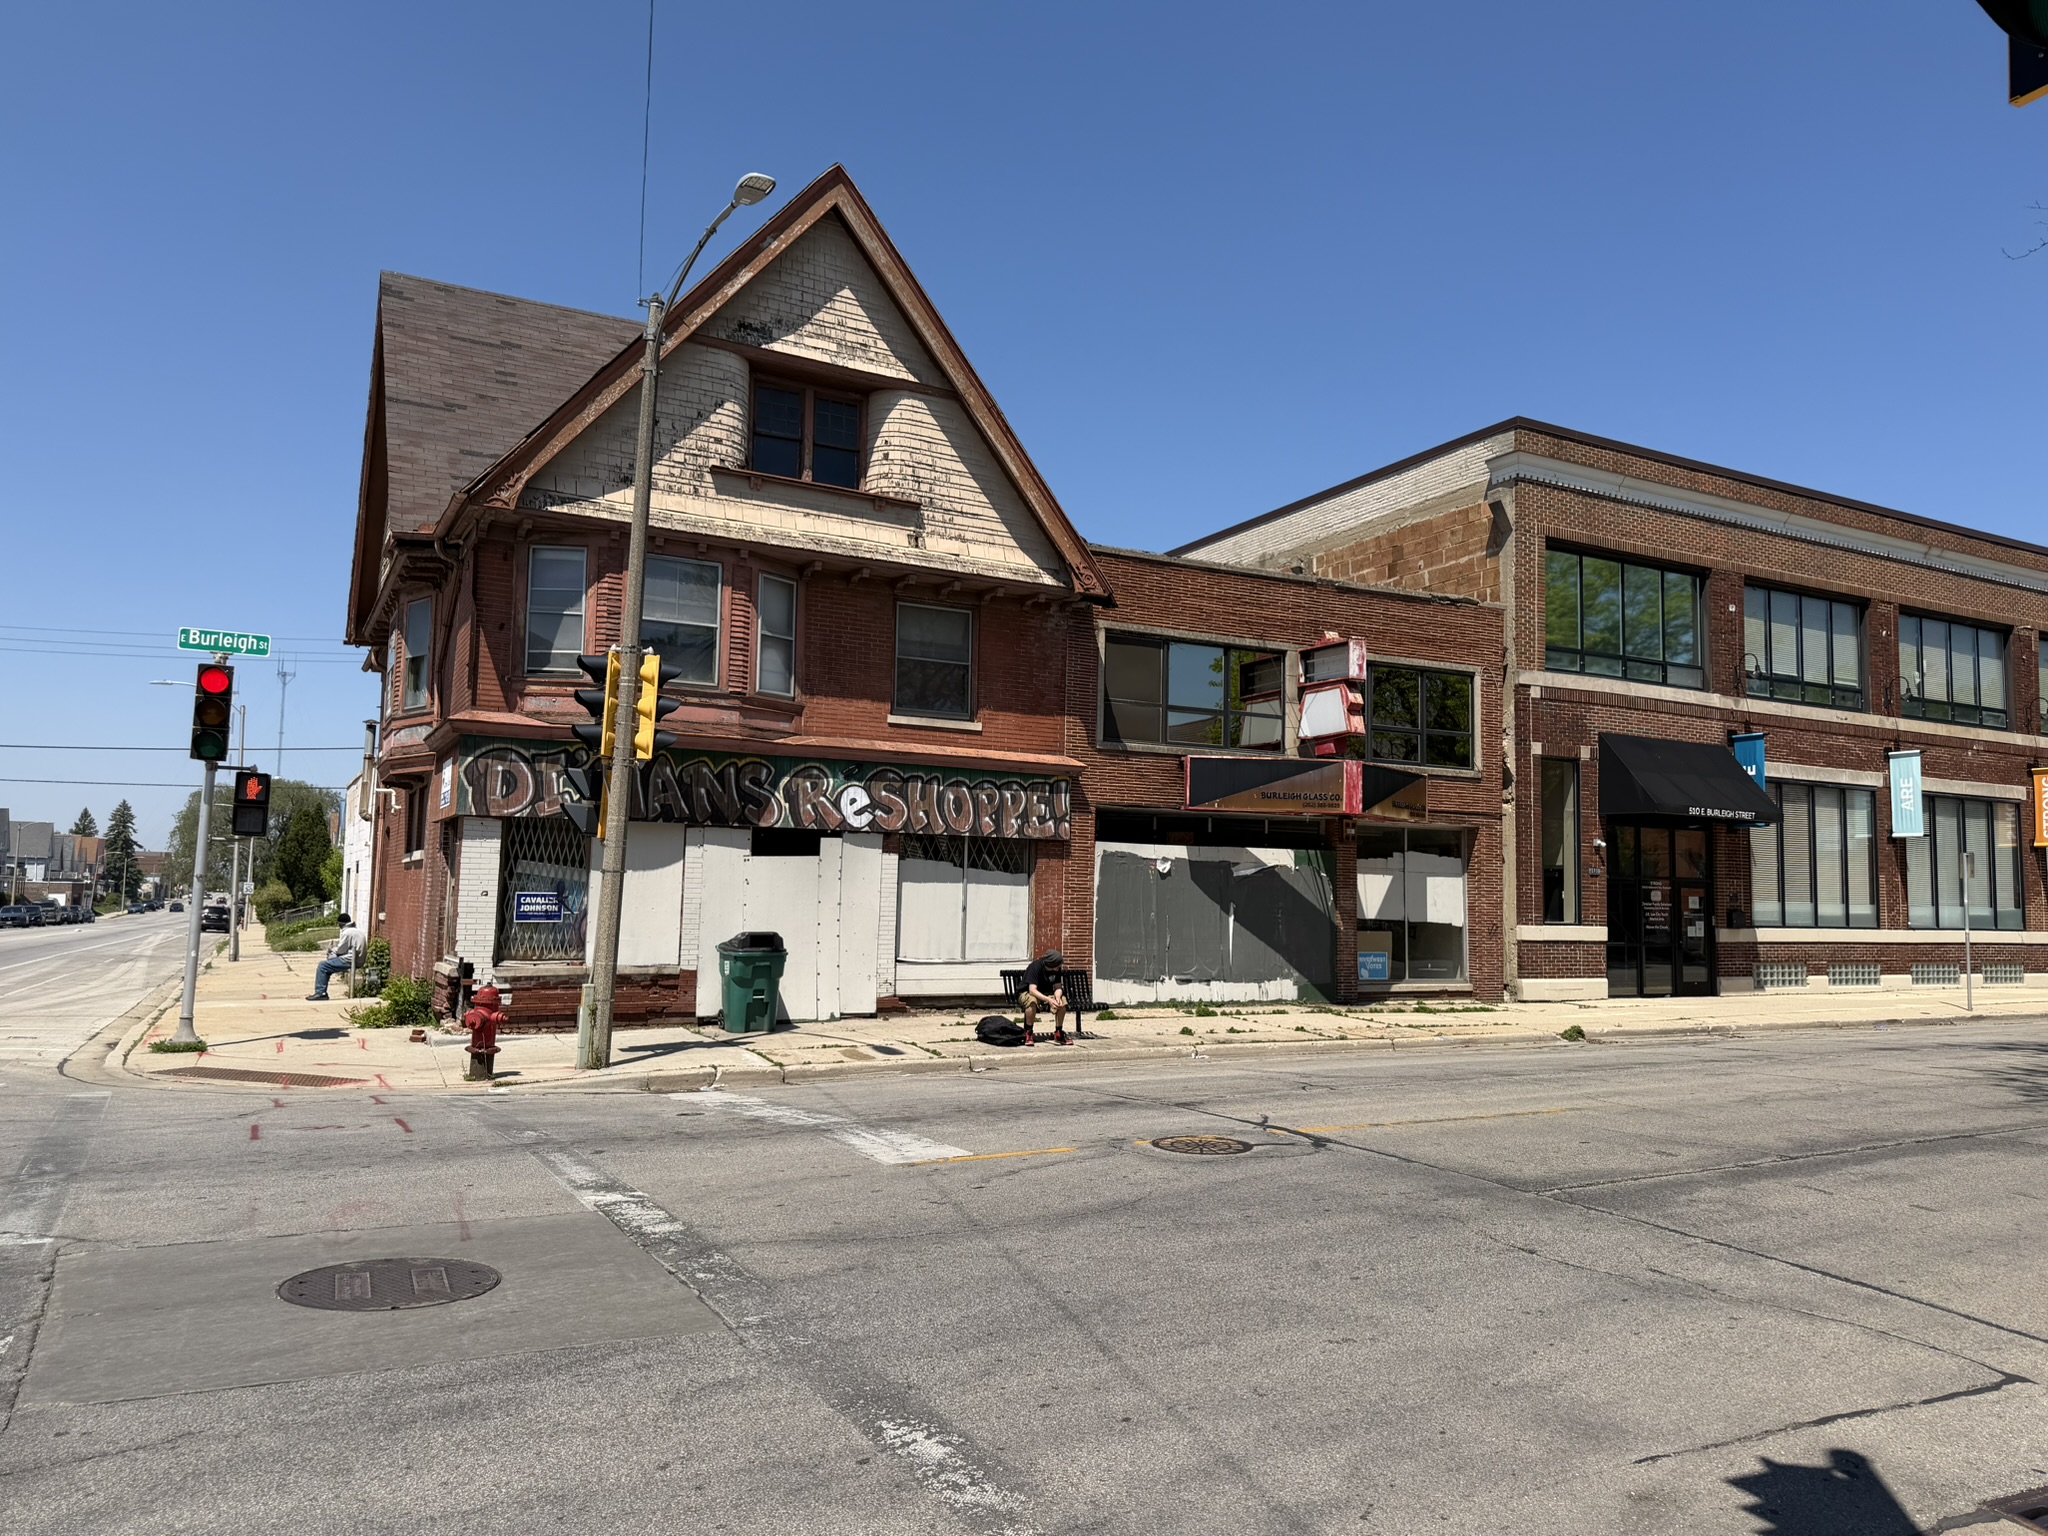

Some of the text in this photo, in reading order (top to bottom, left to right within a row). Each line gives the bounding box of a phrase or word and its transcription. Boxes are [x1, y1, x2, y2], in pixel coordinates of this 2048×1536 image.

[181, 629, 268, 653] E Burleigh St
[1261, 791, 1343, 802] BURLEIGH GLASS CO.
[1901, 777, 1914, 812] ARE
[1689, 806, 1700, 816] 510
[1707, 808, 1735, 818] BURLEIGH
[1735, 810, 1756, 820] STREET
[519, 904, 559, 912] JOHNSON
